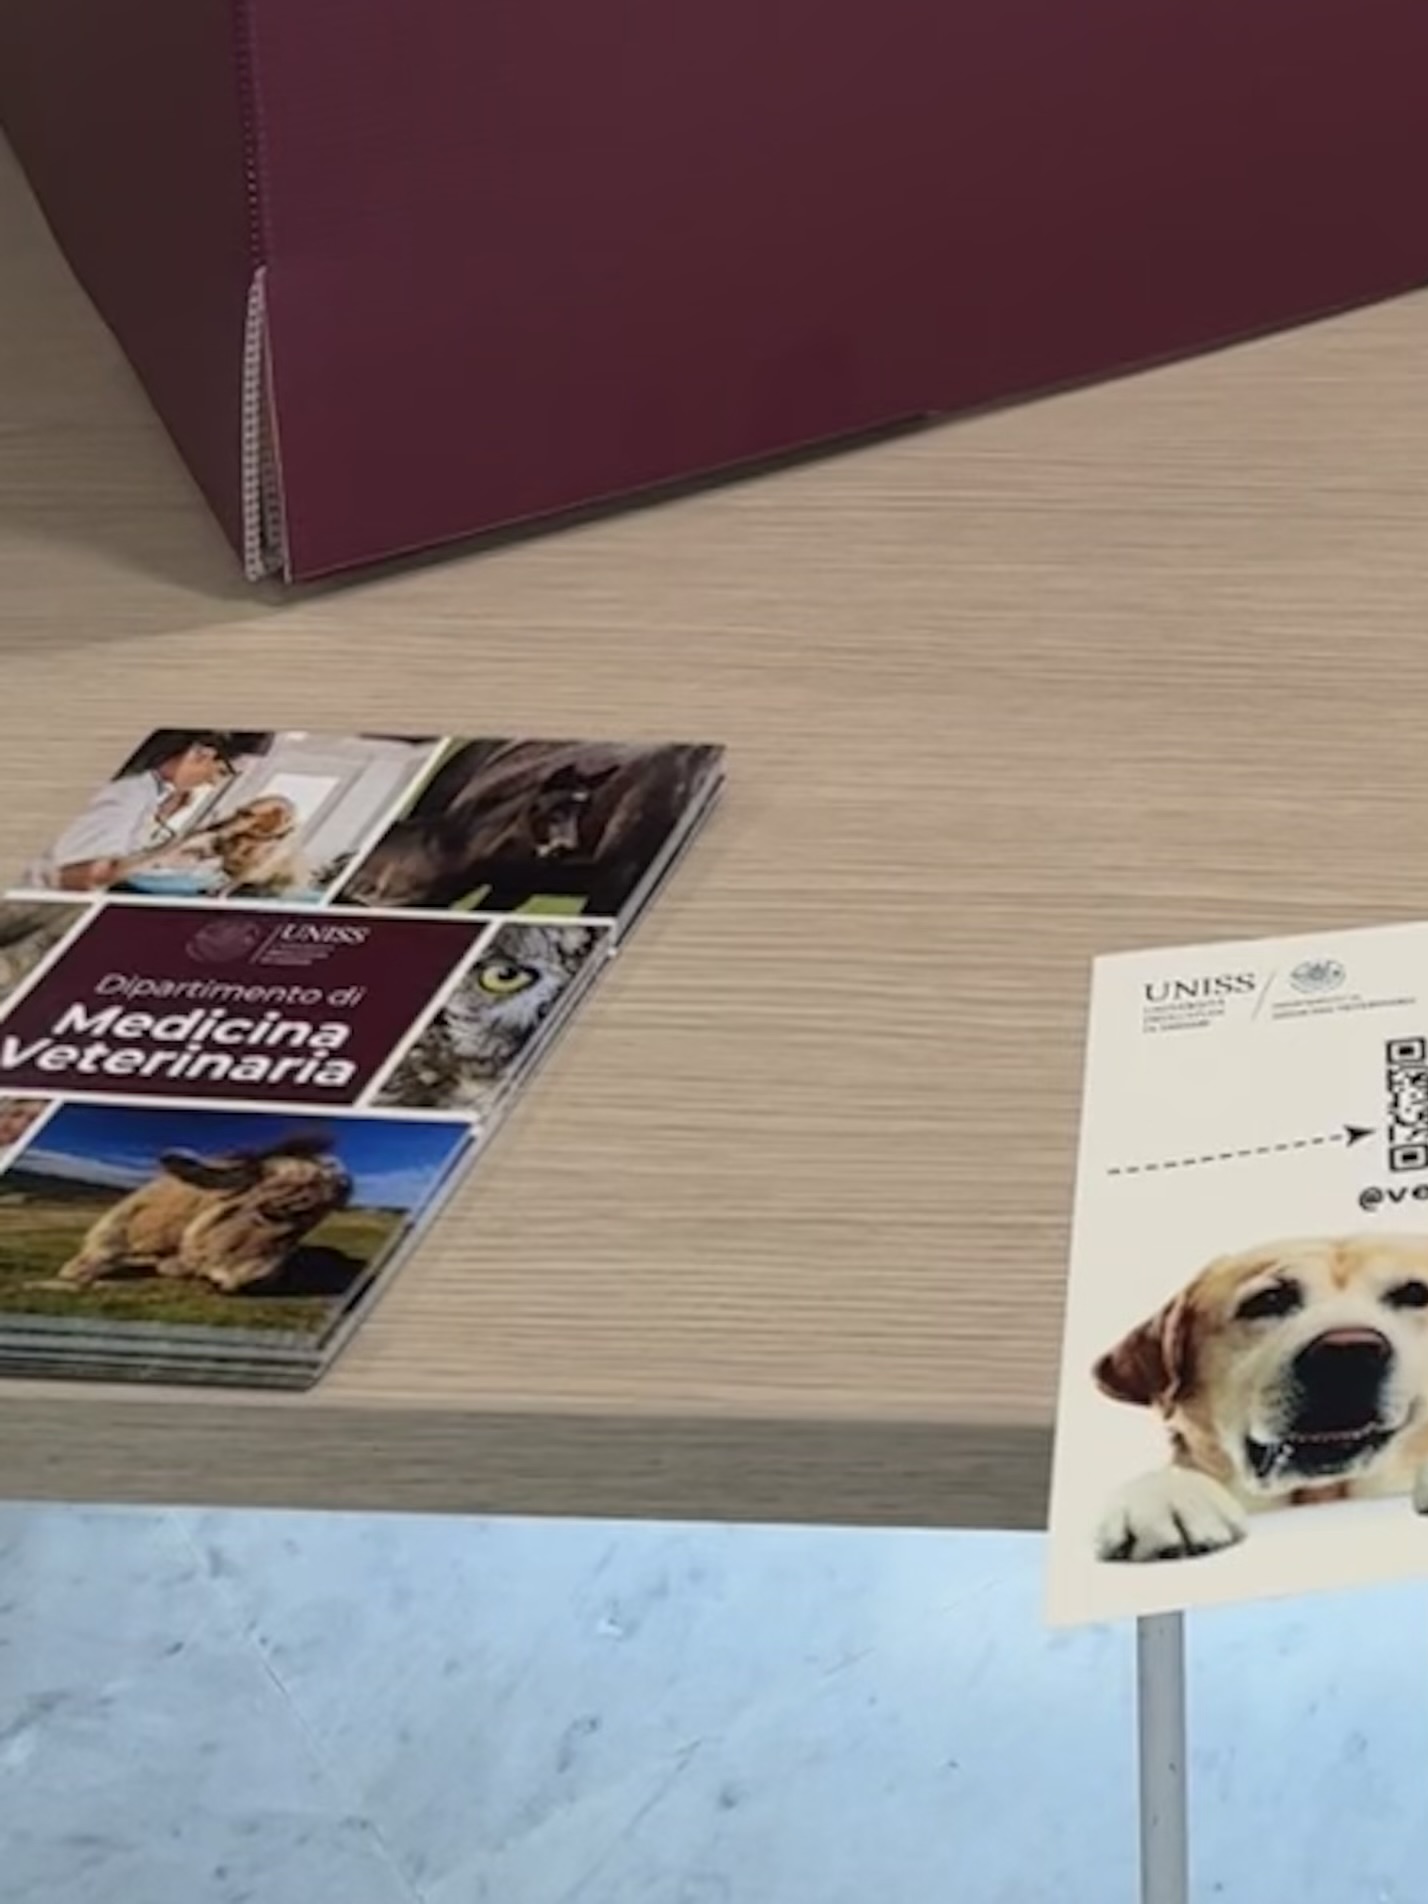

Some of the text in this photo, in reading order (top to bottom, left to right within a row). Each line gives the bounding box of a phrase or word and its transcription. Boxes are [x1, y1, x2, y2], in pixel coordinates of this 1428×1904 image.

[280, 923, 371, 944] UNISS
[94, 973, 367, 1007] Dipartimento di
[1145, 972, 1256, 1002] UNISS
[53, 1002, 351, 1050] Medicina
[0, 1036, 357, 1087] Veterinaria
